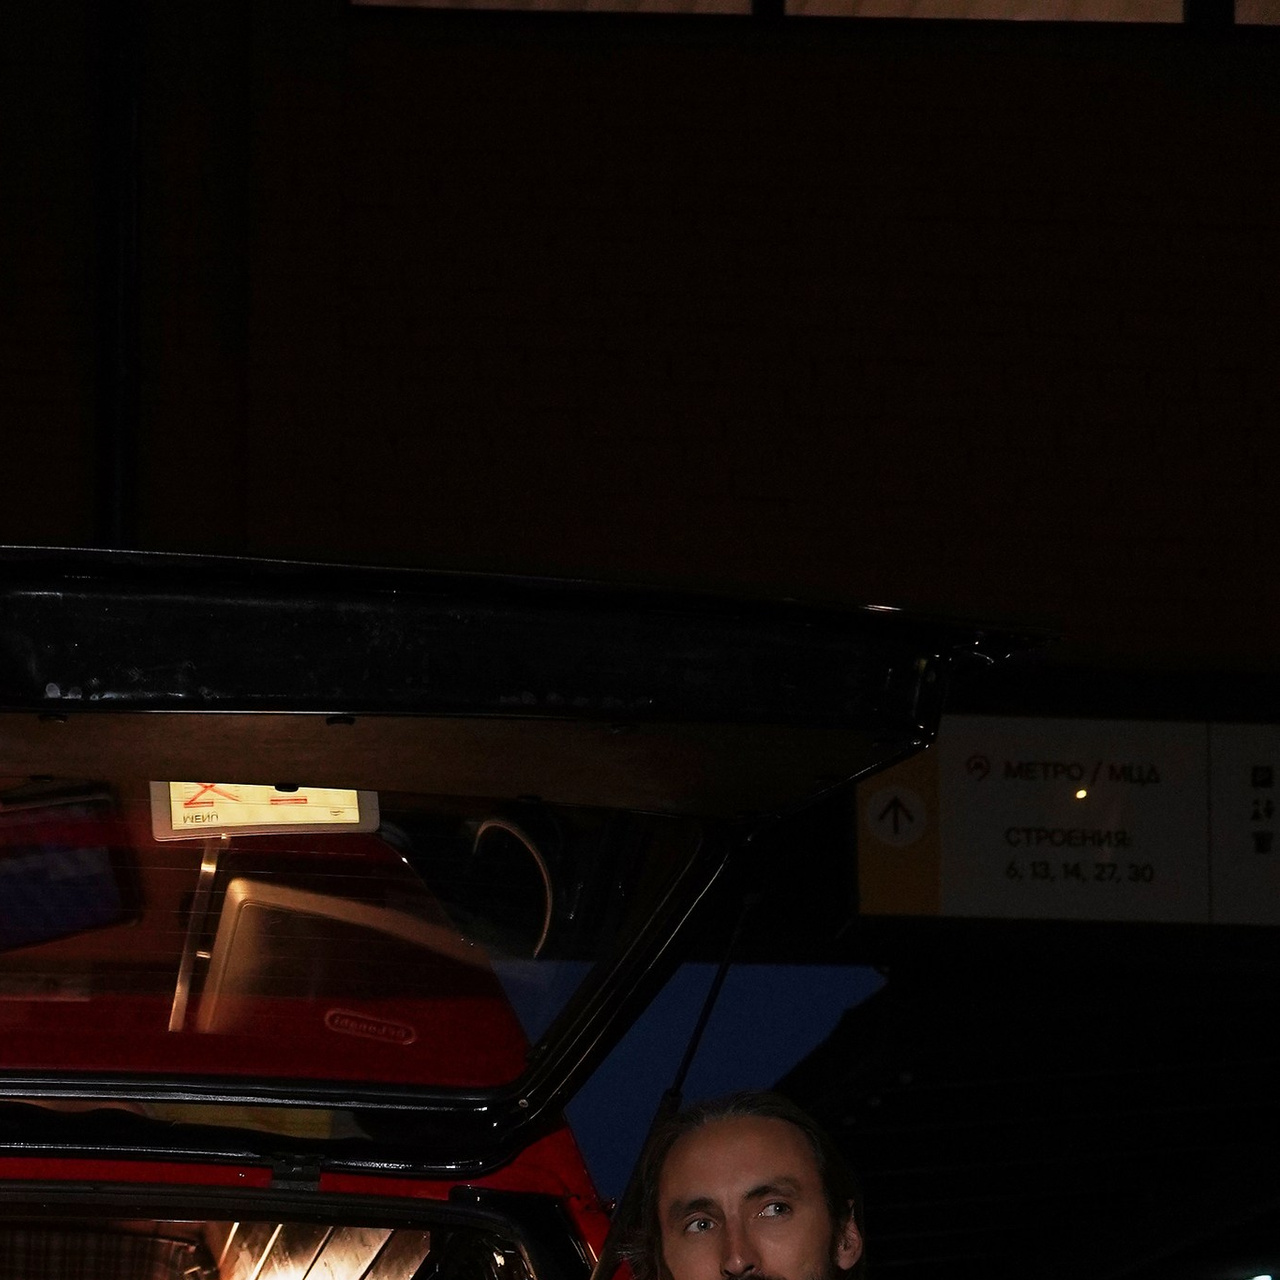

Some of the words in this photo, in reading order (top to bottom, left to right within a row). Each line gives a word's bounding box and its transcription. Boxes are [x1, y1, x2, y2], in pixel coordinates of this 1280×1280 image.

[1004, 762, 1084, 782] МЕТРО
[1094, 863, 1122, 883] 27,
[1128, 864, 1155, 883] 30
